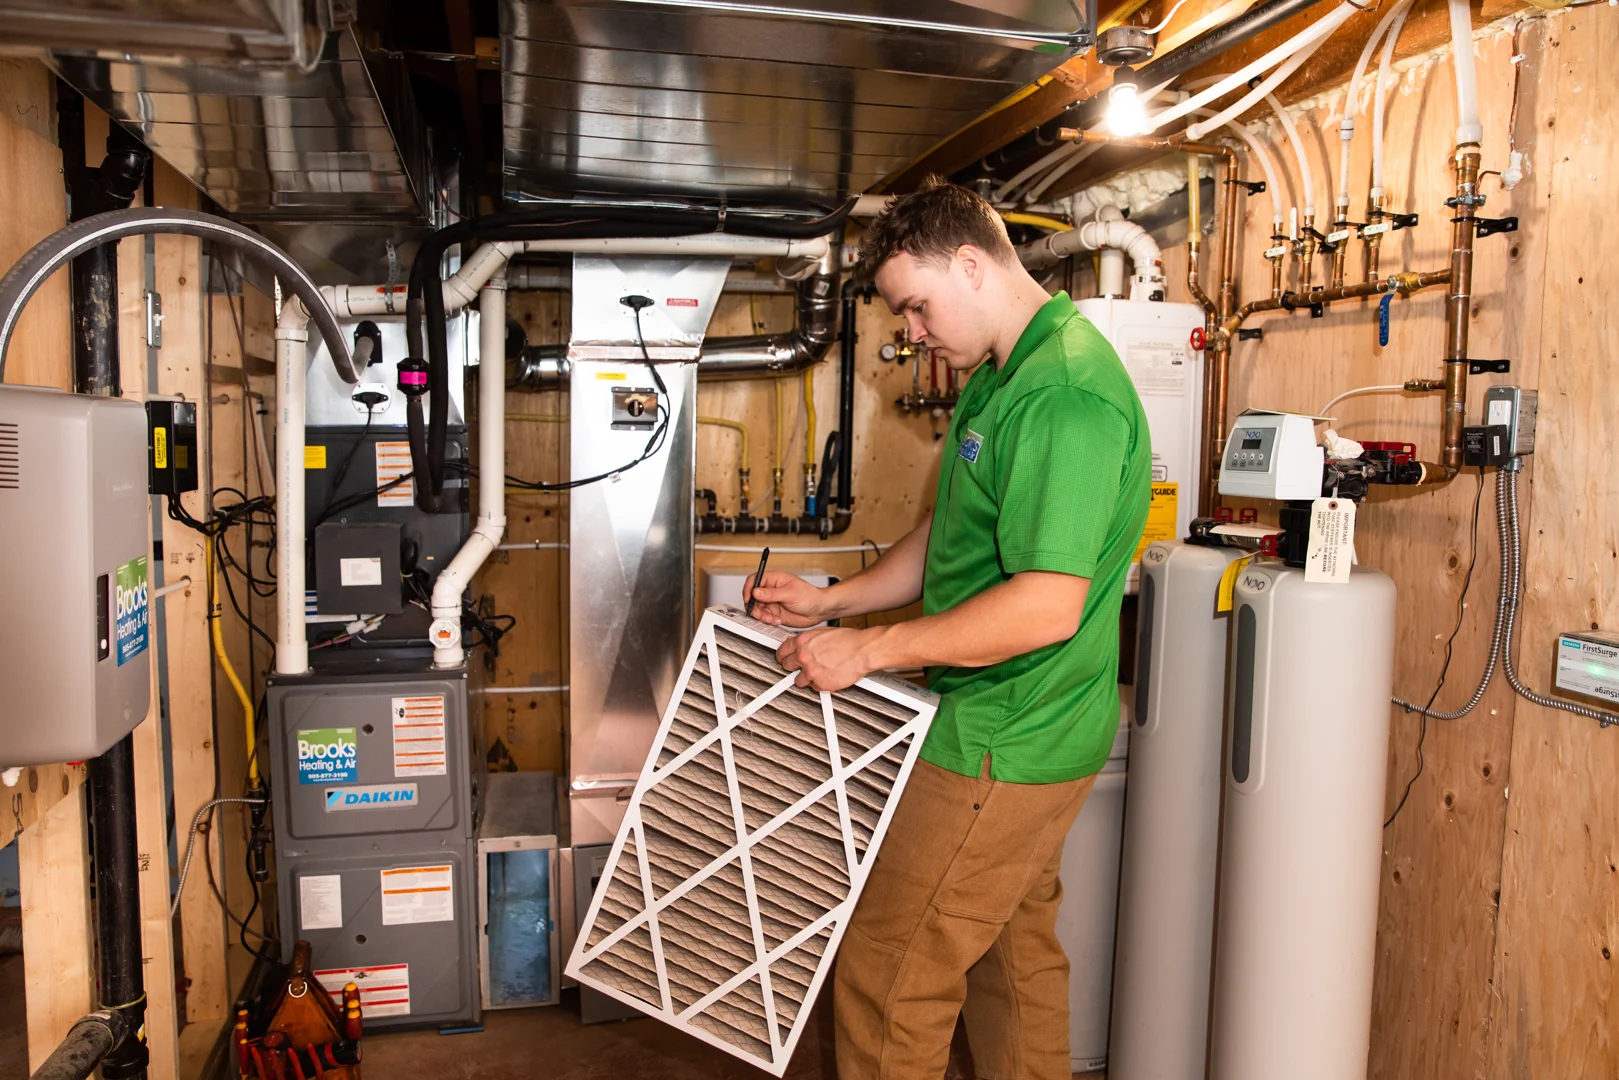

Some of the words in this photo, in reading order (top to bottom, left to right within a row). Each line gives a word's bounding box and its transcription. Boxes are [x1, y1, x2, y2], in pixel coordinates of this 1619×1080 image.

[116, 575, 148, 621] Brooks
[117, 617, 137, 640] Heating
[137, 612, 141, 629] &
[1582, 644, 1618, 658] FirstSurge
[298, 738, 356, 760] Brooks
[299, 760, 334, 772] Heating
[336, 759, 343, 769] &
[344, 758, 357, 769] Air
[344, 790, 414, 805] DAIKIN
